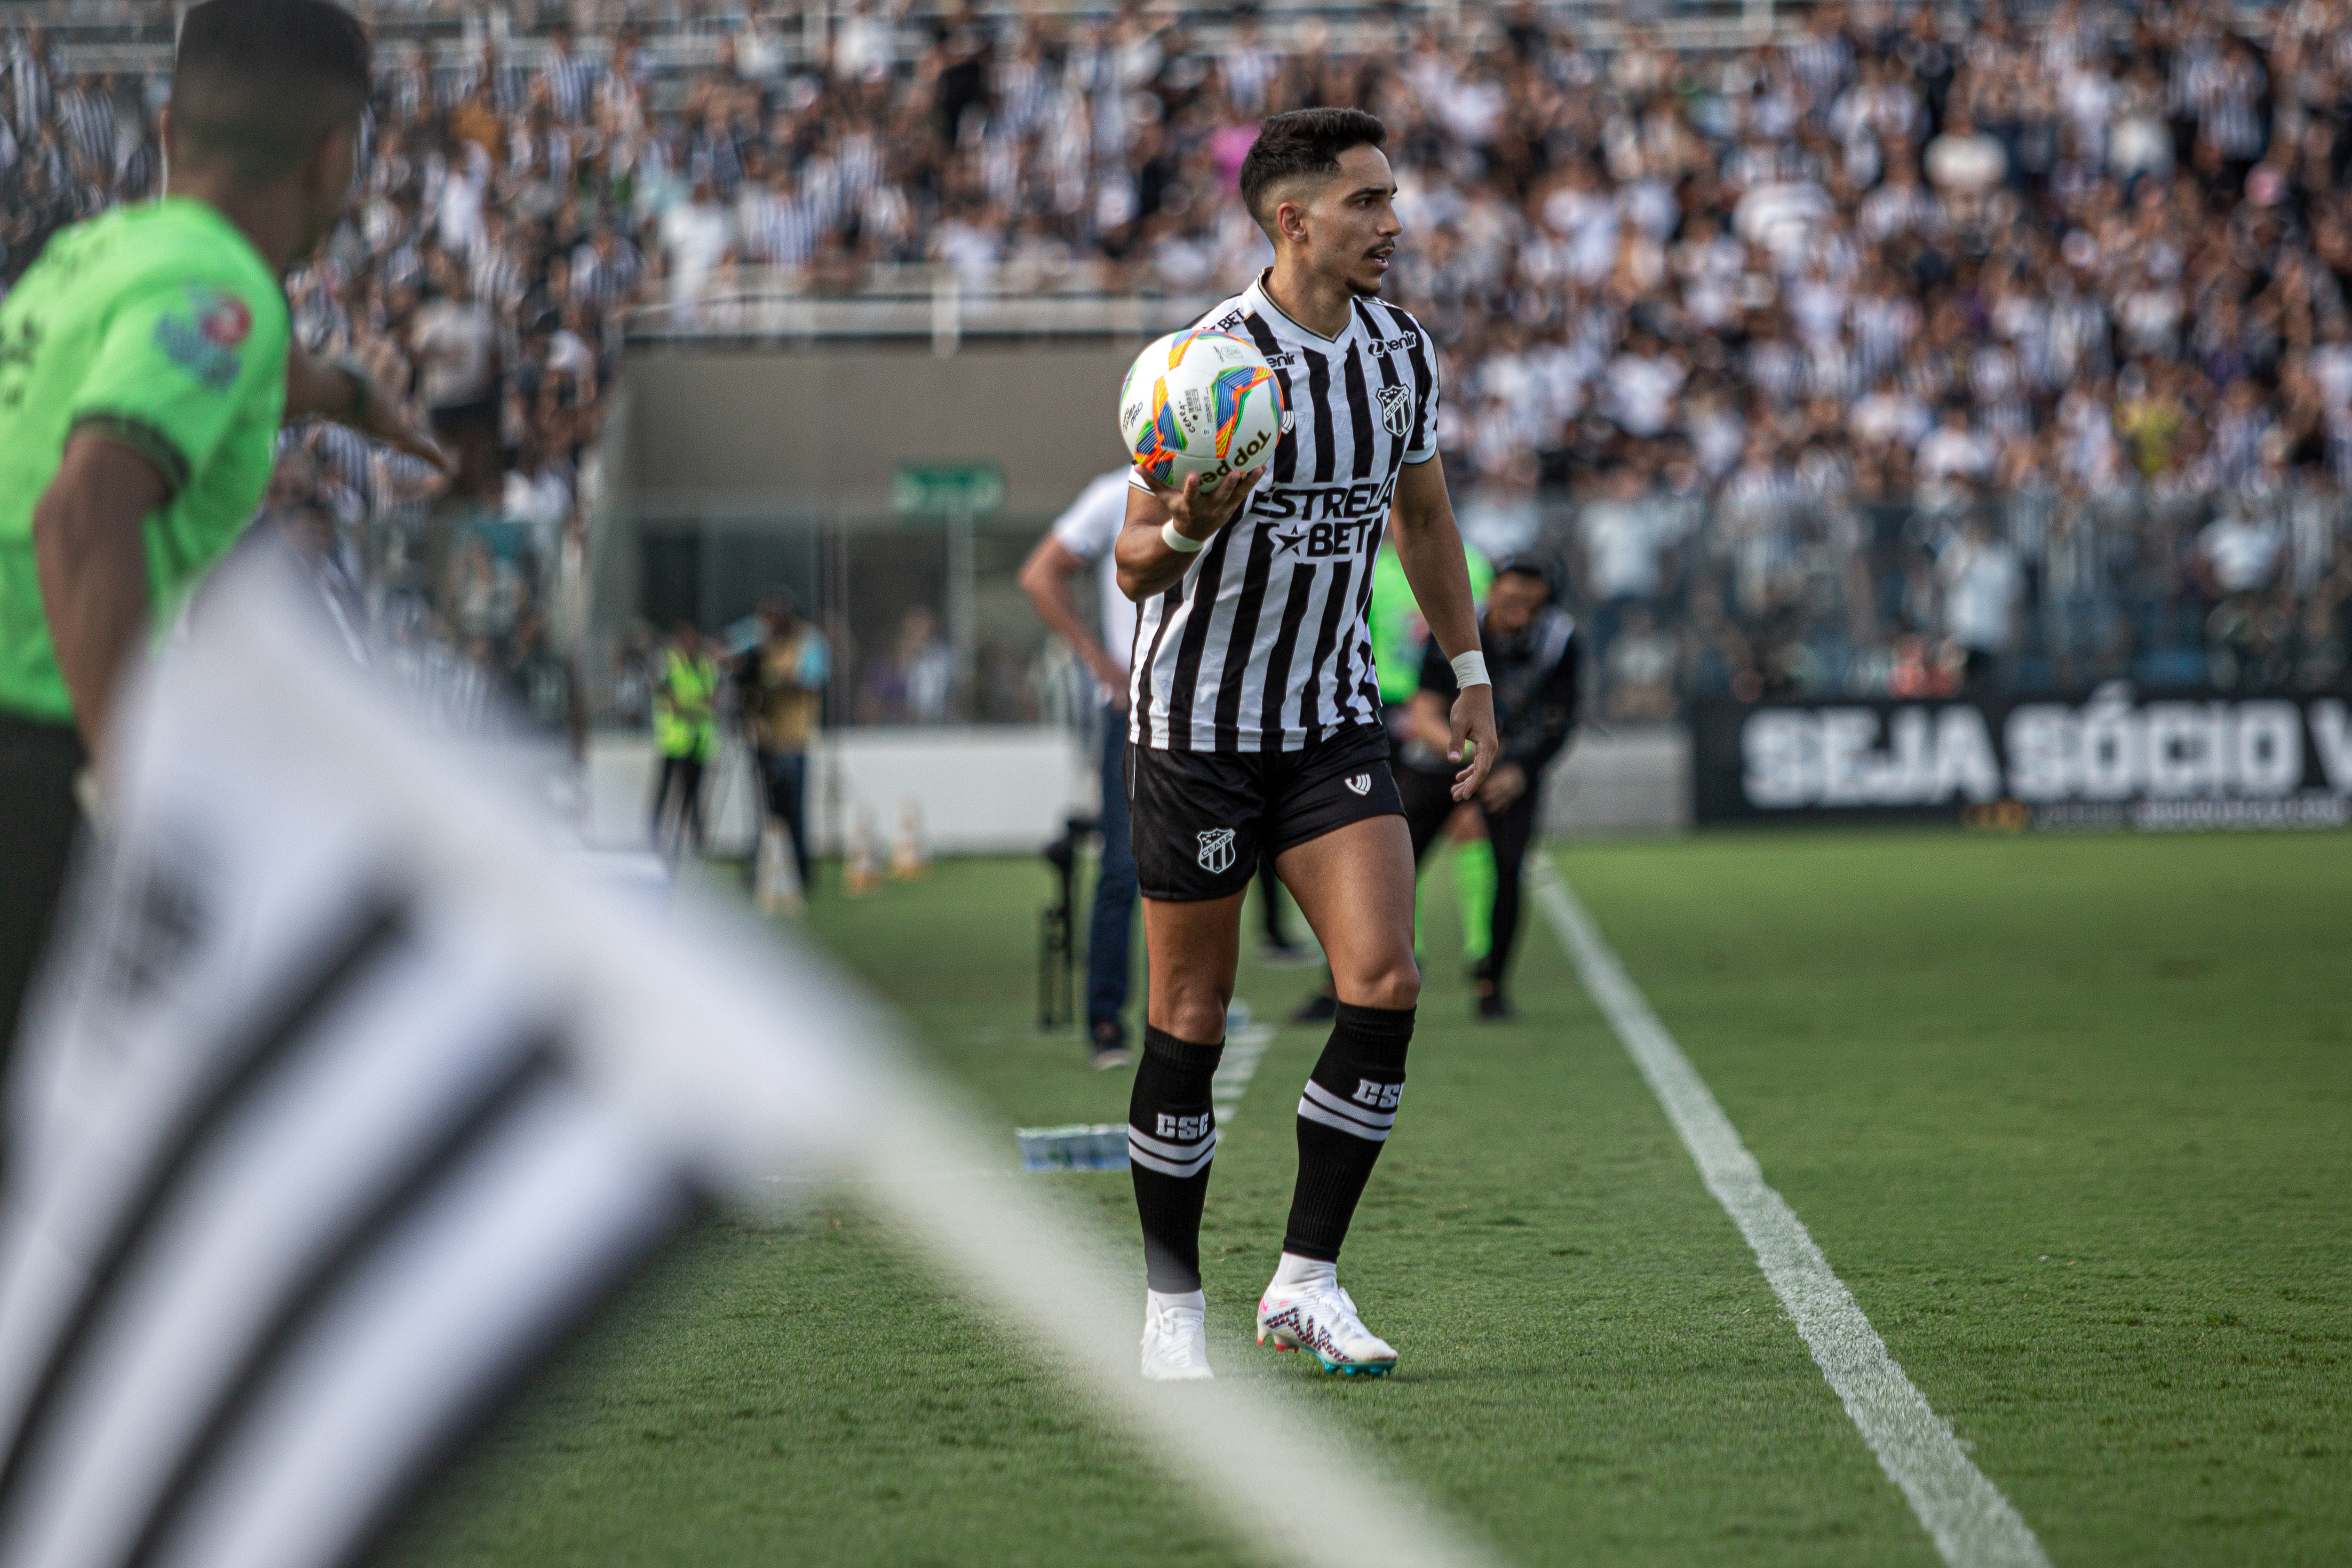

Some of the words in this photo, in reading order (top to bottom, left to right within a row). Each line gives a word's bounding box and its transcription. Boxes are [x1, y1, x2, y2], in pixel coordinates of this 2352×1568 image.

[1217, 307, 1245, 333] BET
[1266, 352, 1295, 368] enir
[1131, 401, 1143, 427] PRO
[1249, 477, 1396, 521] ESTRELA
[1307, 518, 1373, 557] BET
[1743, 704, 2002, 806] SEJA
[2004, 680, 2304, 801] SÓCIO
[1352, 1078, 1404, 1108] CS
